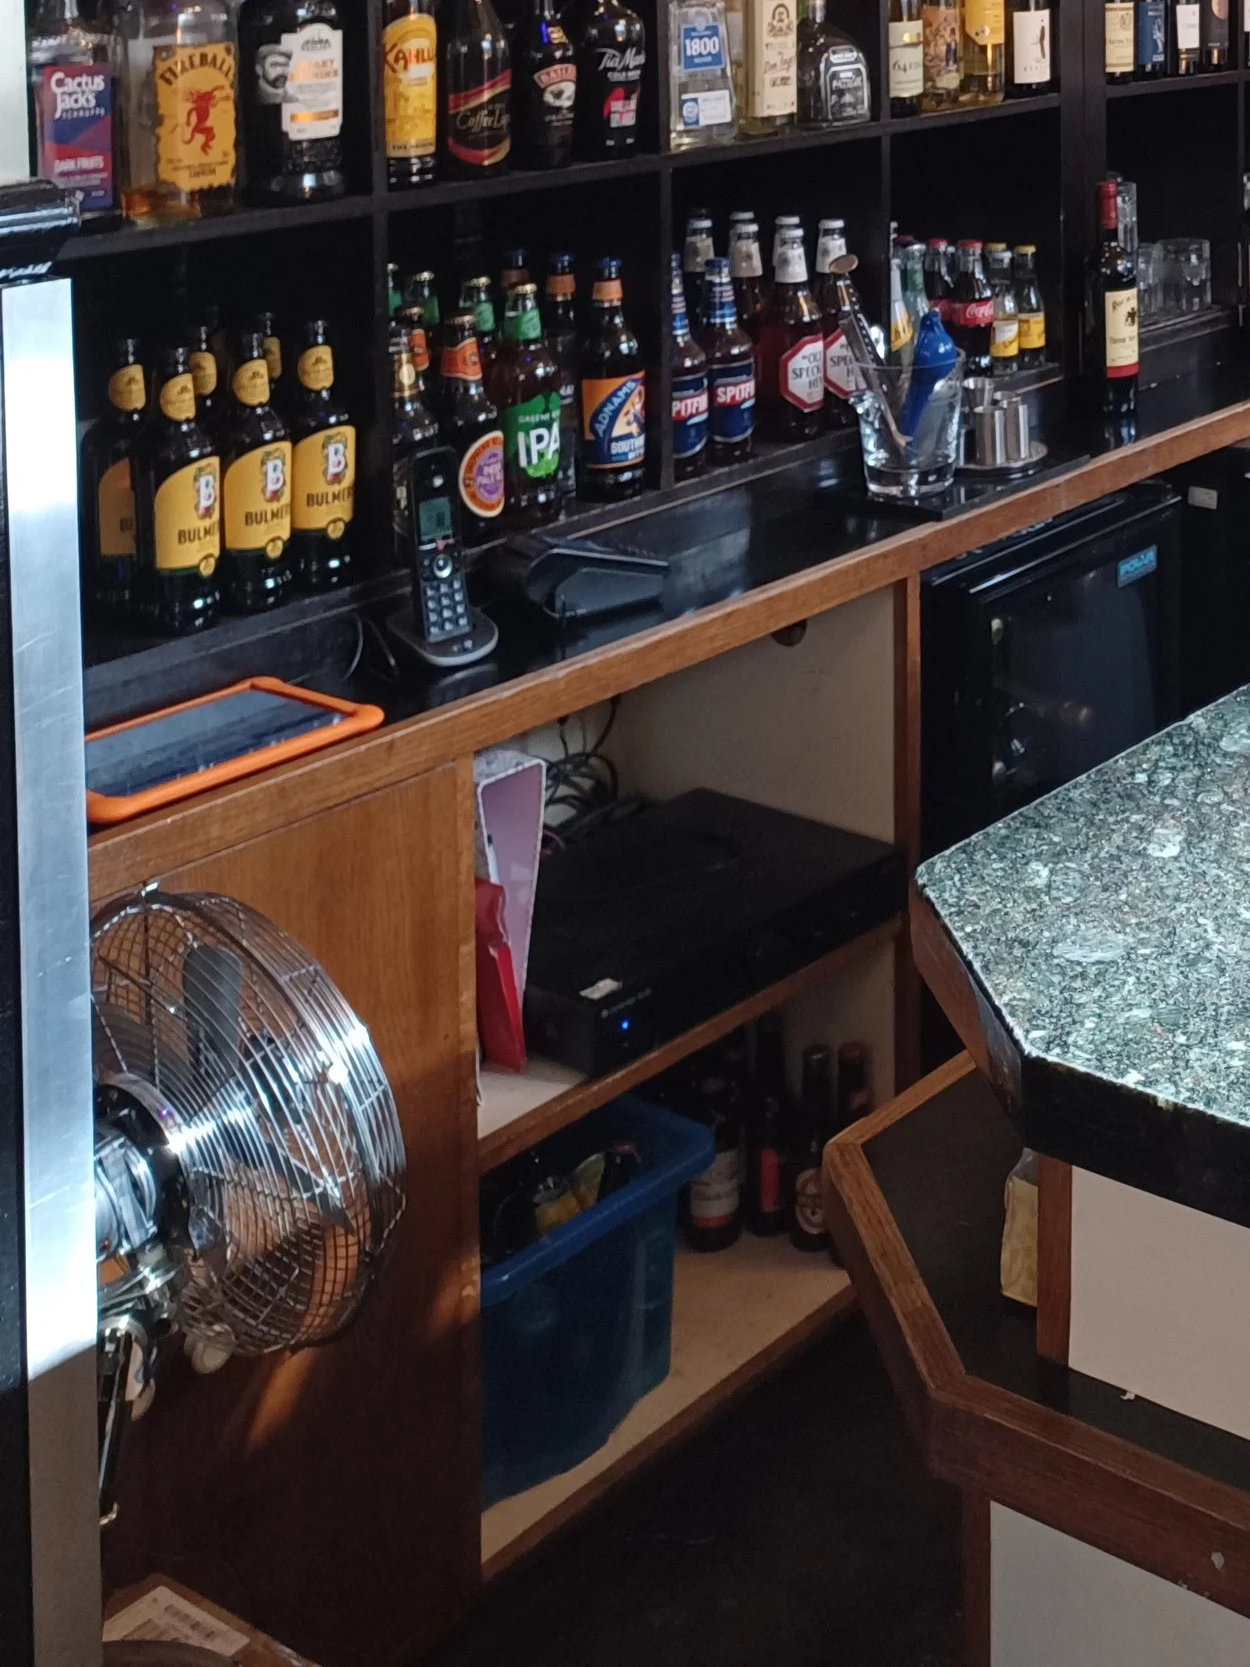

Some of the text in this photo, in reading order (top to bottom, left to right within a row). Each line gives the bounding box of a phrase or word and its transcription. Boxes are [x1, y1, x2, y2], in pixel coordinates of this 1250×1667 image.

[383, 41, 437, 74] KAHLU
[685, 36, 720, 57] 1800
[50, 71, 106, 94] Cactus
[159, 51, 233, 87] FIREBALL
[456, 109, 495, 134] Coffee
[593, 379, 638, 437] ADNAMS
[517, 422, 560, 469] IPA
[306, 486, 353, 509] BULMER
